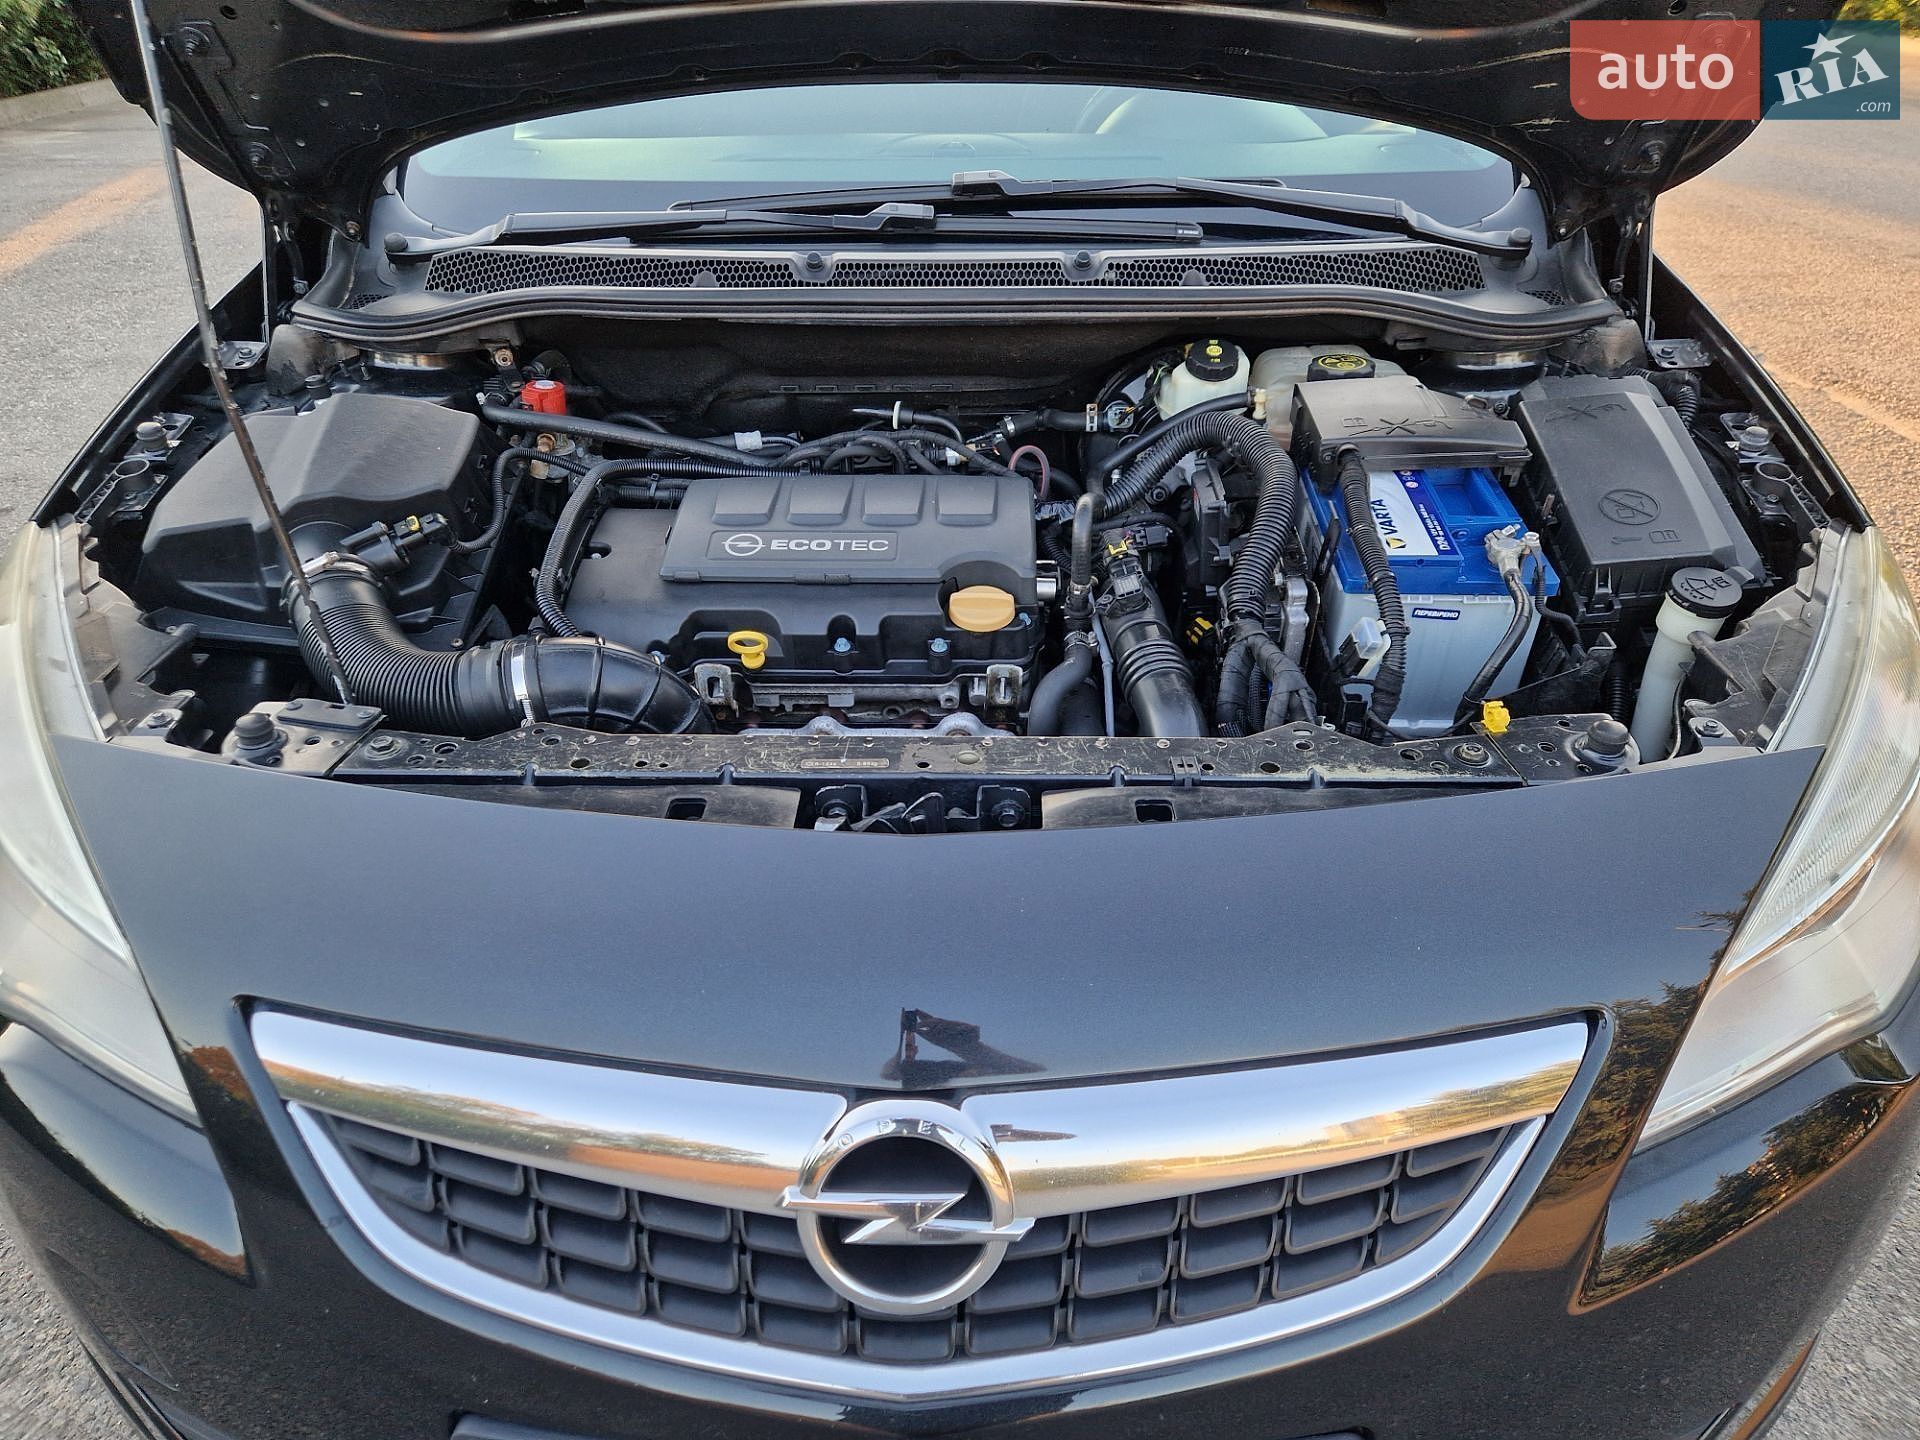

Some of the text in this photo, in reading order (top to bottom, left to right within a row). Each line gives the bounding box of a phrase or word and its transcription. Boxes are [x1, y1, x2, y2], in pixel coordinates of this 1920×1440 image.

[1370, 499, 1398, 535] VARTA
[770, 539, 889, 551] ECOTEC
[837, 1119, 967, 1152] OPEL
